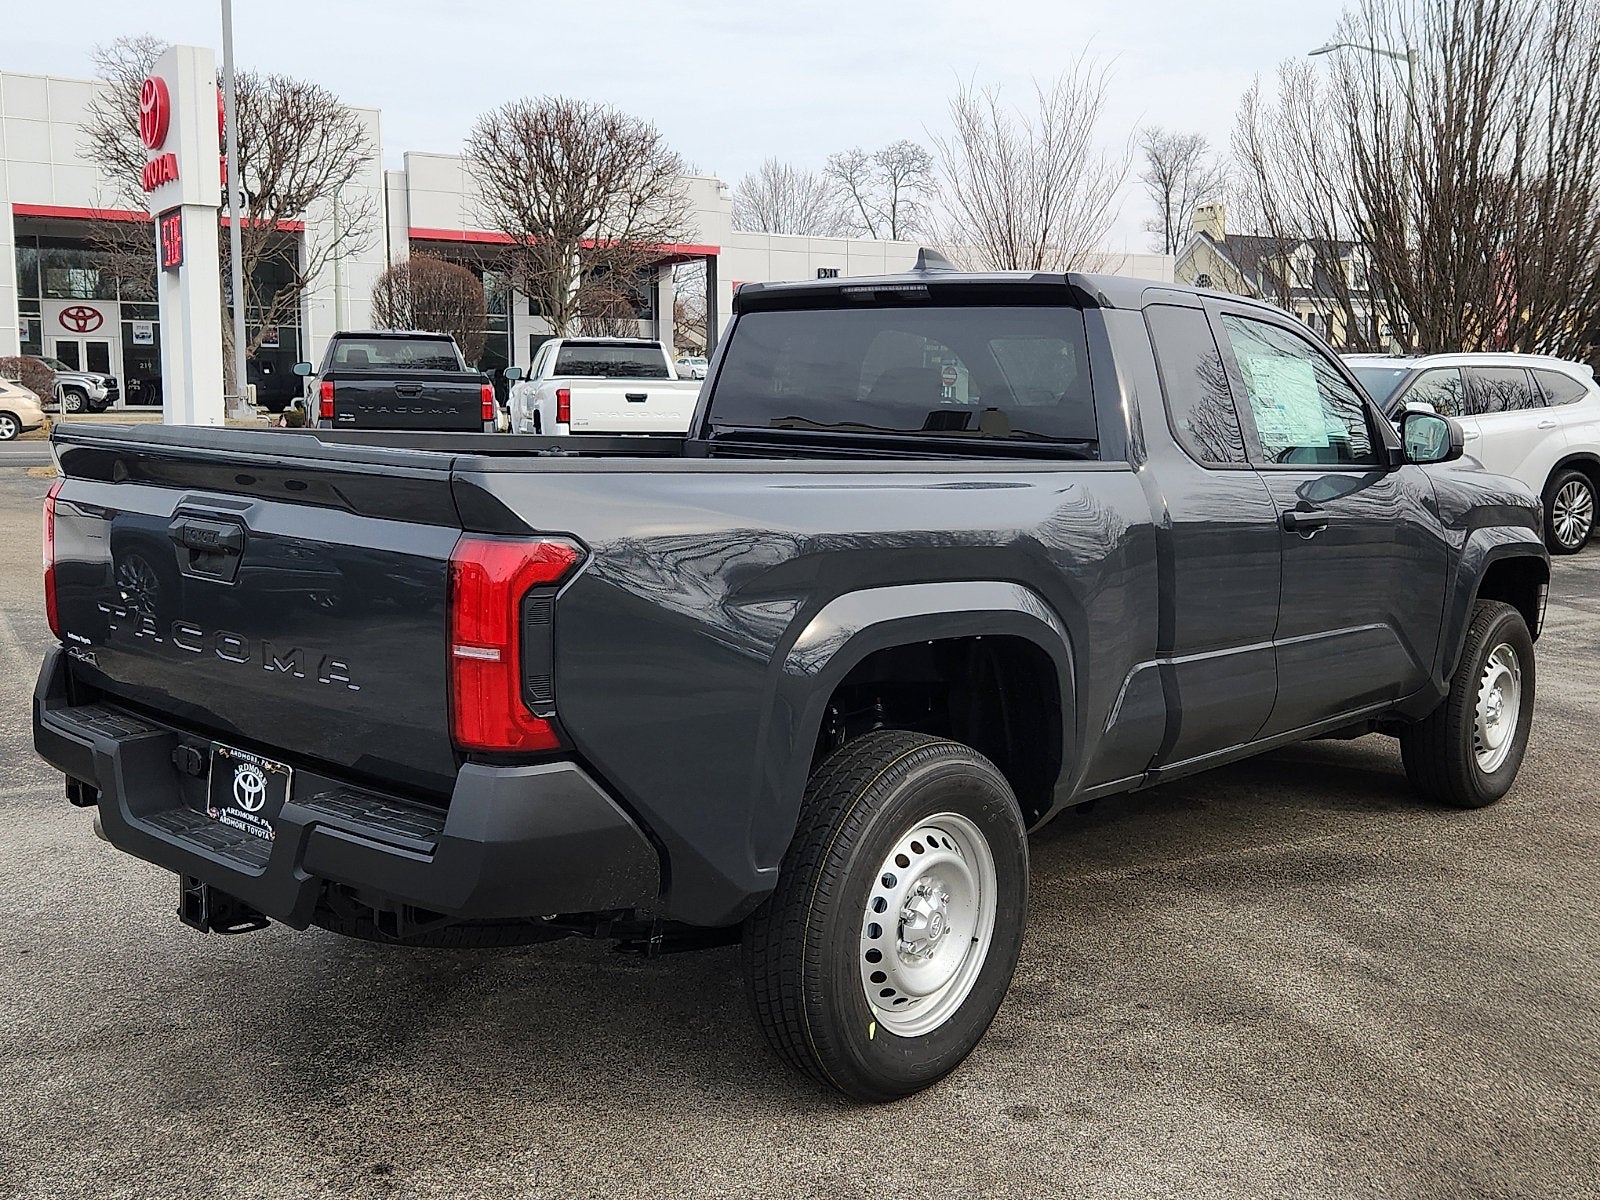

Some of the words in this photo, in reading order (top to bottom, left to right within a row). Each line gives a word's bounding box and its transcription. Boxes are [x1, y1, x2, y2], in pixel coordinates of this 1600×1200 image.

[359, 405, 459, 414] TACOMA
[97, 602, 361, 690] TACOMA
[234, 763, 268, 787] ARDMORE
[220, 816, 246, 831] ARDMORE
[247, 825, 270, 841] TOYOTA
